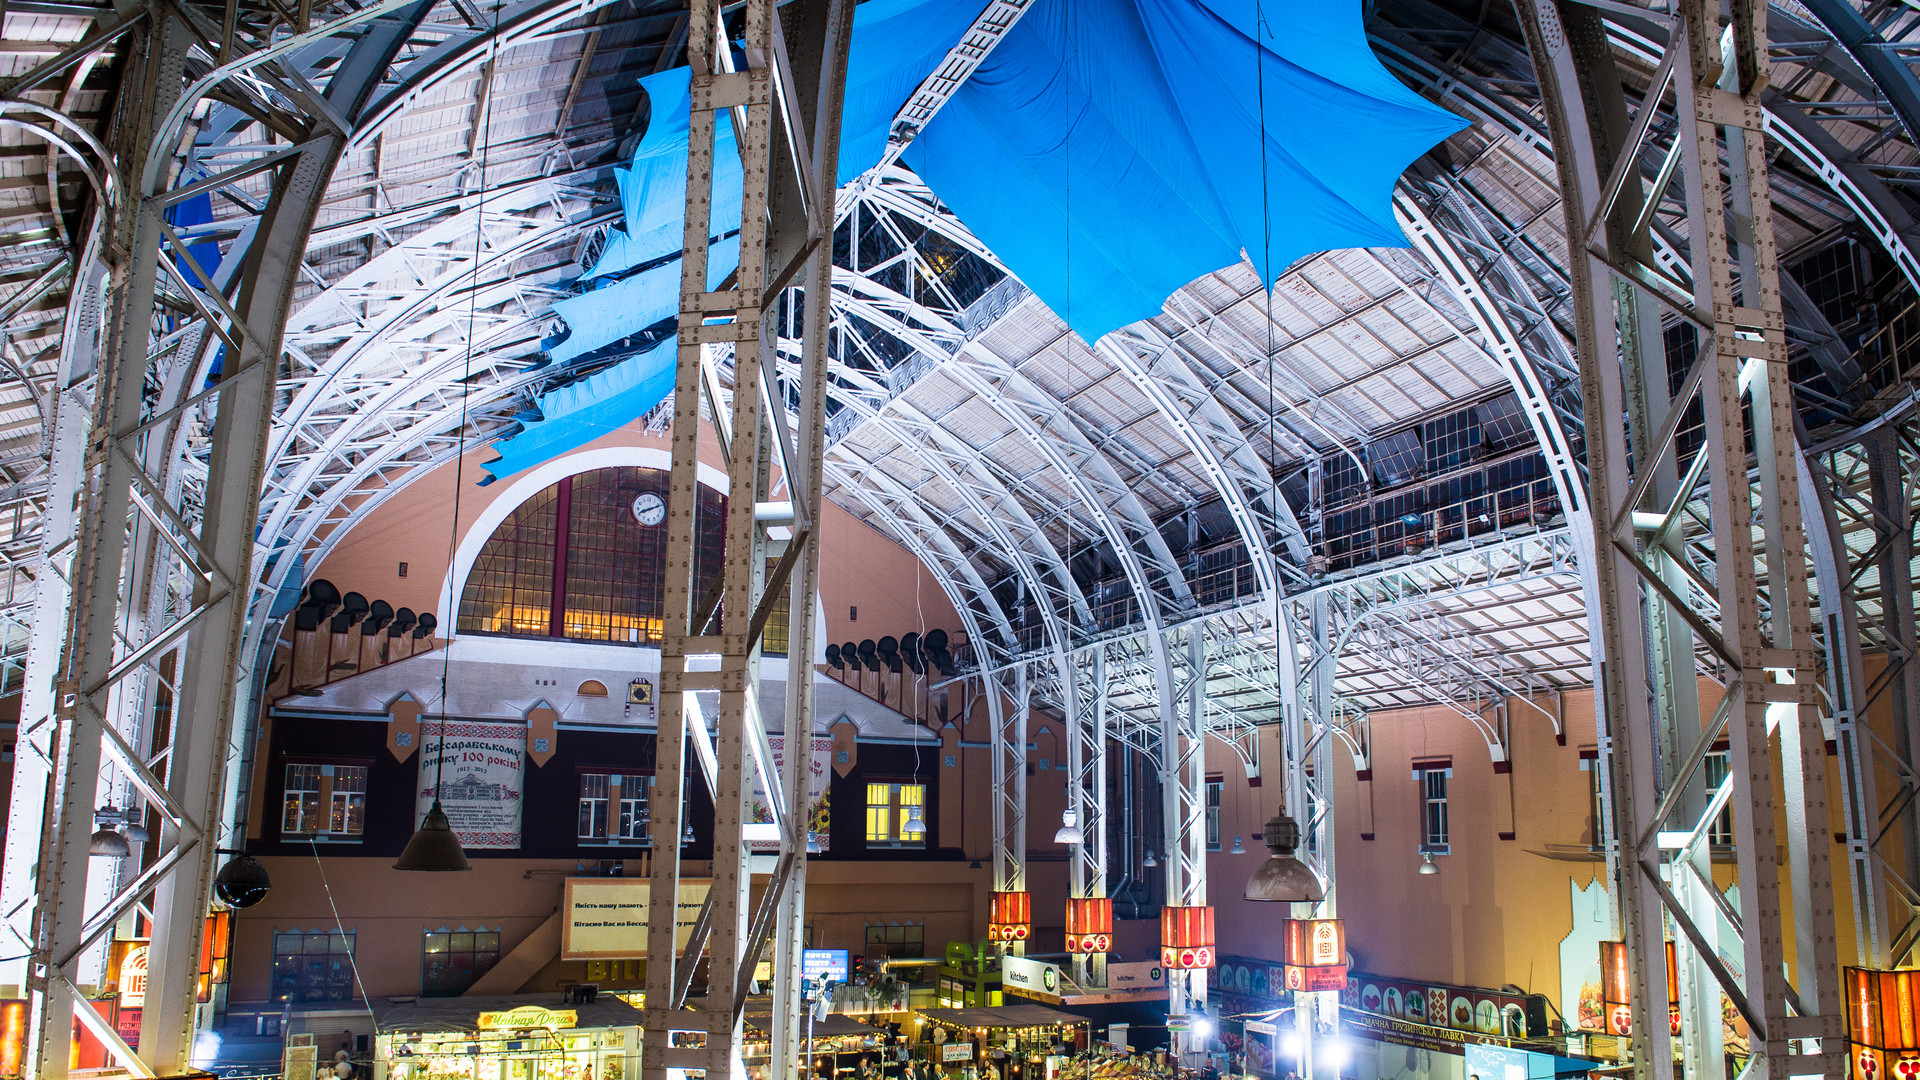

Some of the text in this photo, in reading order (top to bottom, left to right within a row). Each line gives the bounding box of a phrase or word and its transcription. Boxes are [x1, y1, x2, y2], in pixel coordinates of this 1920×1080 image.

[462, 752, 484, 762] 100
[487, 756, 521, 771] років!
[474, 766, 488, 774] 2012
[1009, 970, 1056, 987] kitchen 13
[1151, 969, 1160, 978] 13
[131, 1013, 141, 1022] ПЛ
[492, 1012, 568, 1027] Чайная Роза
[1360, 1016, 1390, 1030] СМАЧНА
[1391, 1021, 1437, 1038] ГРУЗИНСЬКА
[1438, 1029, 1465, 1042] ЛАВКА
[945, 1044, 970, 1053] ЦВЕТЫ
